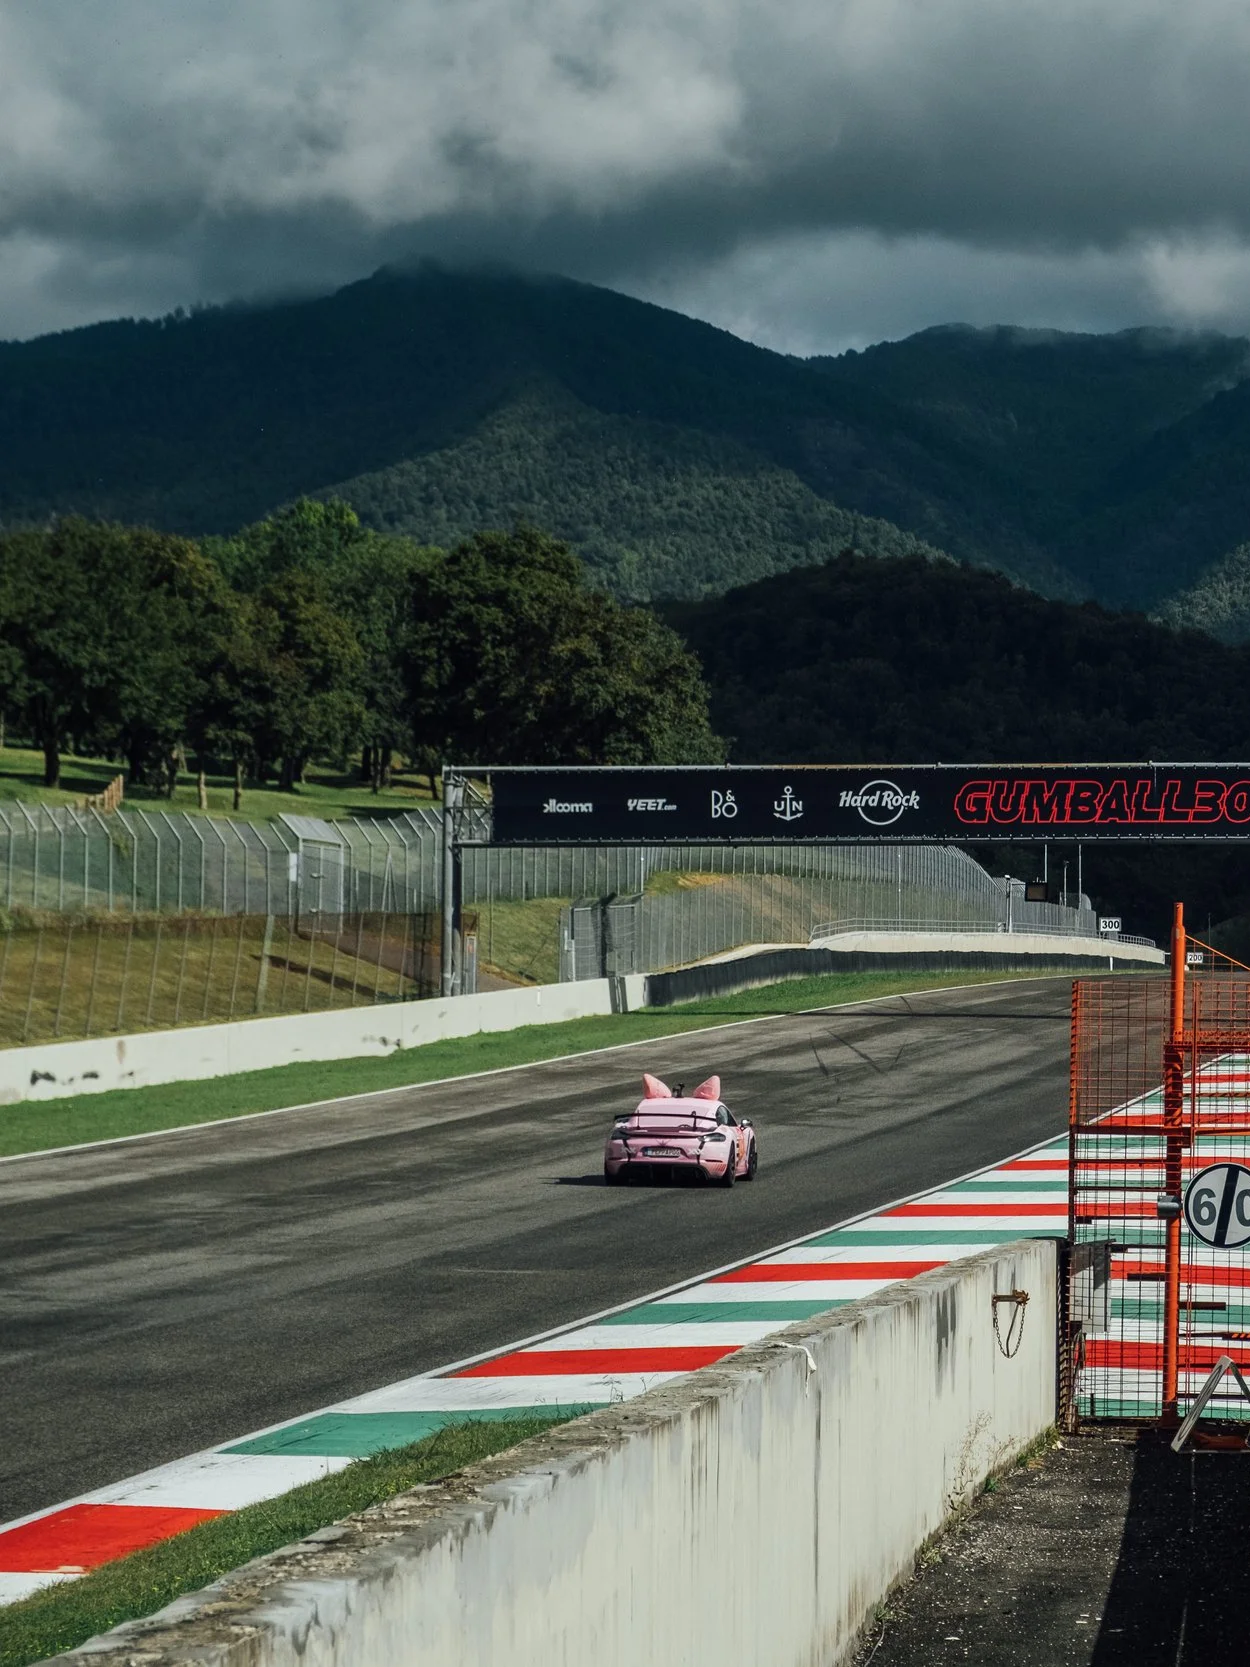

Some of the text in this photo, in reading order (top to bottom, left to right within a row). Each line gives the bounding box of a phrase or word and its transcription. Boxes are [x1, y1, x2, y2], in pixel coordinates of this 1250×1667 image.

[627, 798, 677, 811] YEET.com
[839, 791, 920, 810] Hard Rock
[1102, 920, 1120, 930] 300
